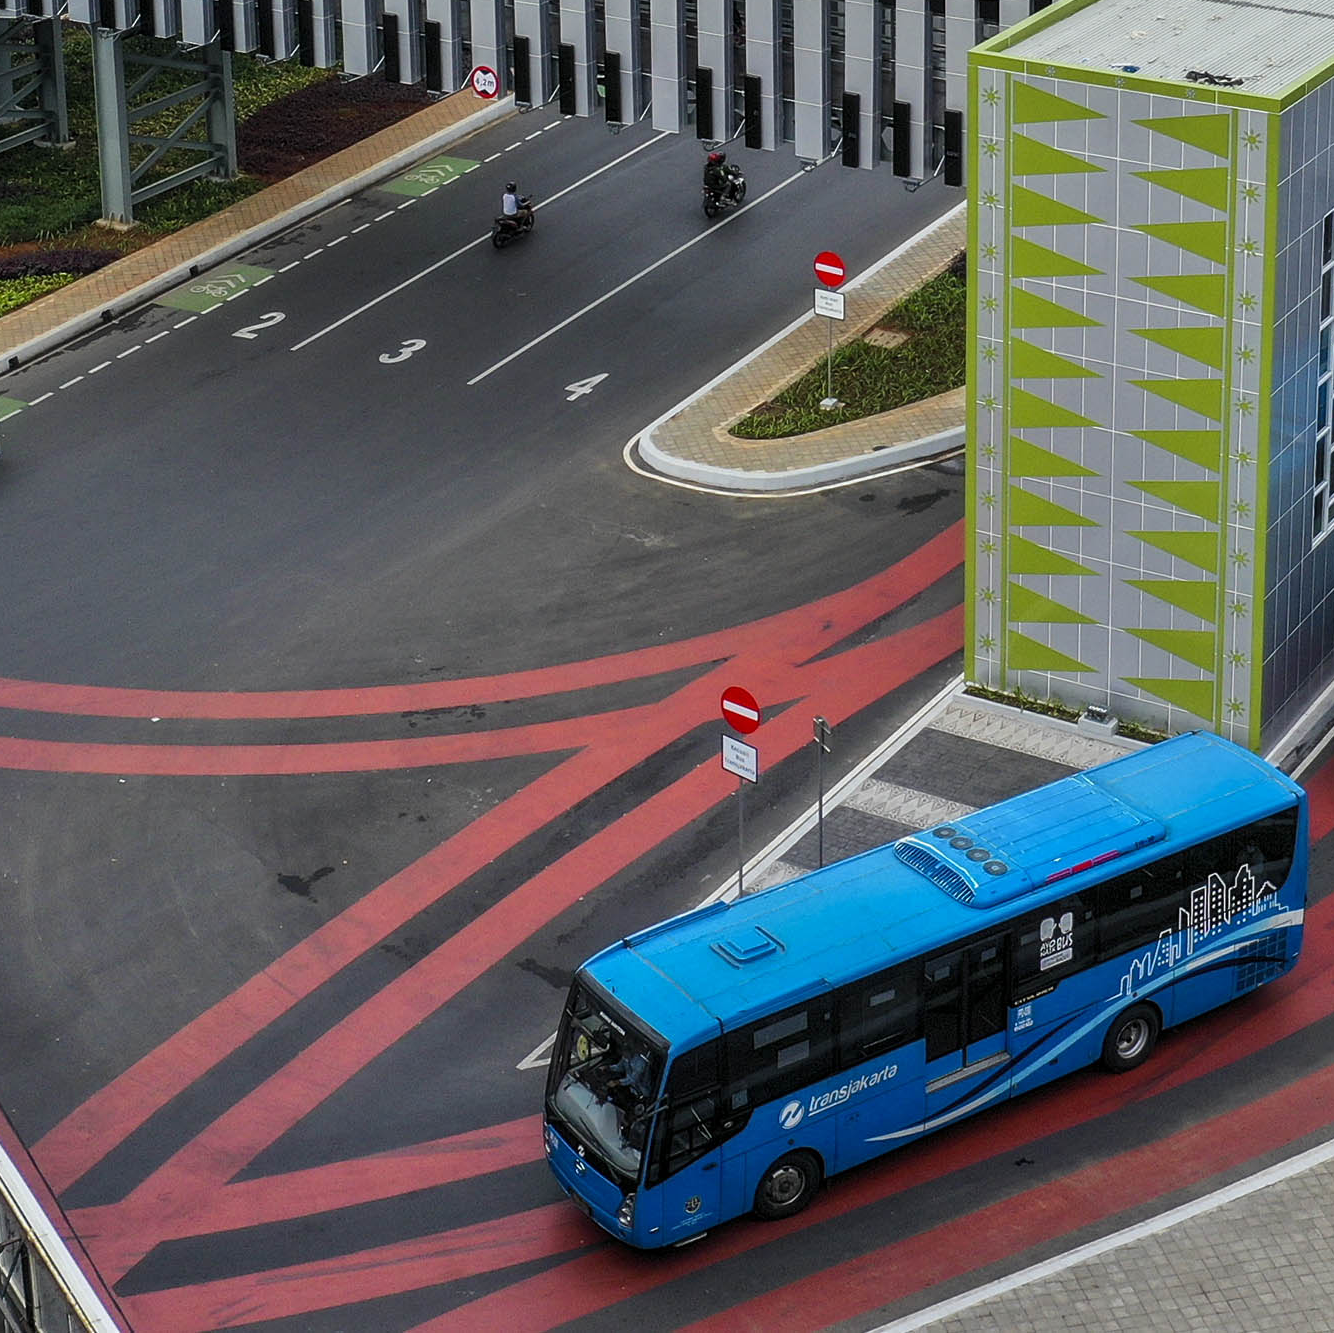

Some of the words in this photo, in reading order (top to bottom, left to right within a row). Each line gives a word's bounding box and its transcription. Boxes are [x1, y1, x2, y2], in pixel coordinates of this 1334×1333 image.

[231, 311, 286, 340] 2
[378, 338, 427, 364] 3
[564, 372, 610, 401] 4
[1056, 932, 1073, 951] BUS
[808, 1064, 899, 1113] transjakarta
